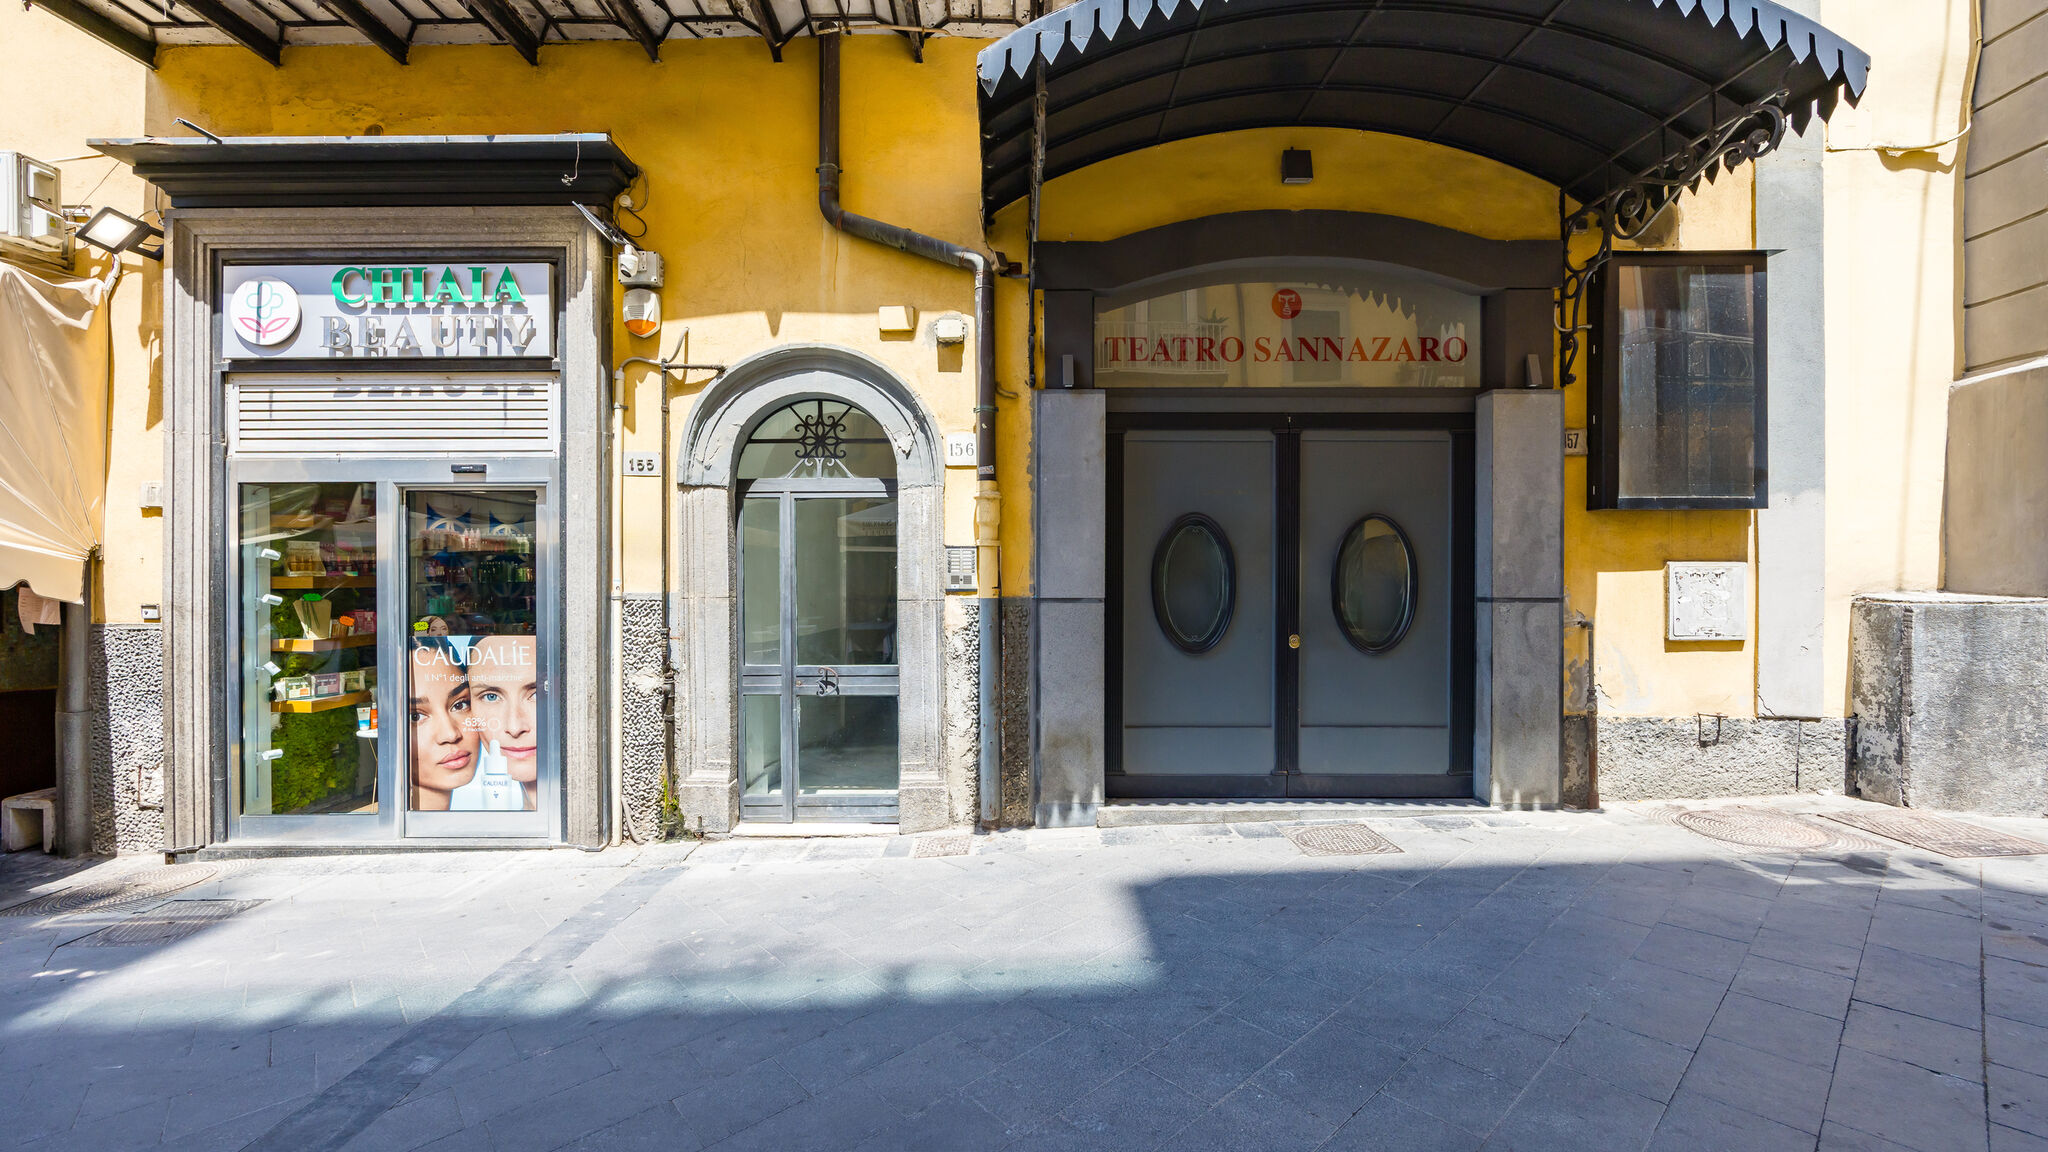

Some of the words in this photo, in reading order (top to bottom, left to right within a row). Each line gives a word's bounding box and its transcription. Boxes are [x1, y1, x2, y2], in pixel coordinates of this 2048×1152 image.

[331, 266, 526, 304] CHIAIA
[319, 315, 533, 349] BEAUTY
[1104, 336, 1245, 363] TEATRO
[1253, 336, 1469, 363] SANNAZARO
[950, 442, 974, 457] 156
[629, 458, 654, 471] 155
[414, 640, 532, 667] CAUDALÍE
[449, 673, 470, 683] degli
